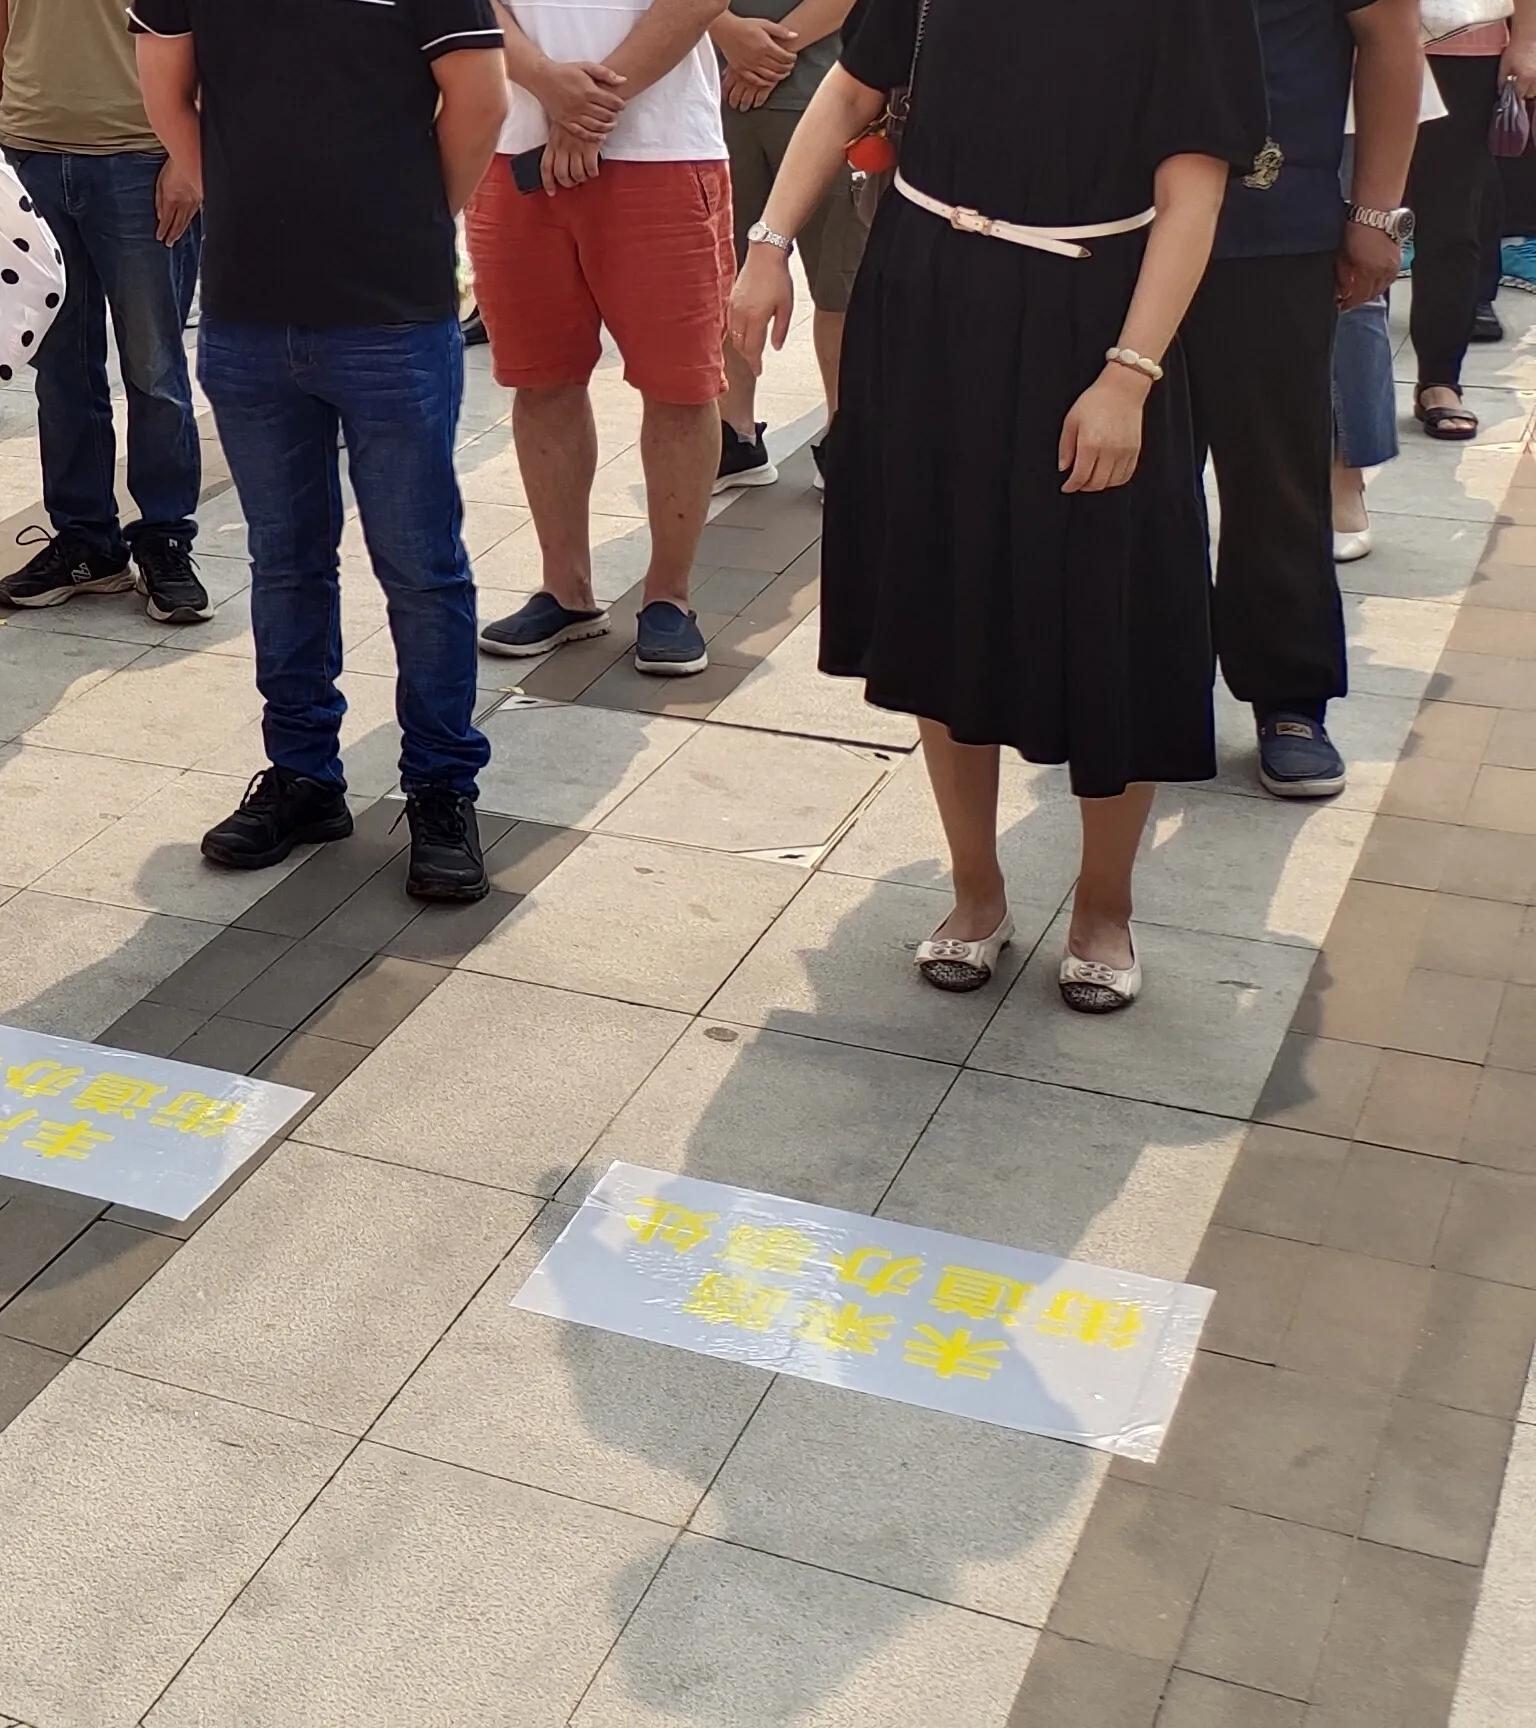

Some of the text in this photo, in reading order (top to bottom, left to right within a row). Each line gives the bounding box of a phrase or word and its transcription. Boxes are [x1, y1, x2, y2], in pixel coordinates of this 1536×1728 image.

[624, 1196, 1144, 1350] 街道办事处
[678, 1271, 1009, 1381] 未来路
